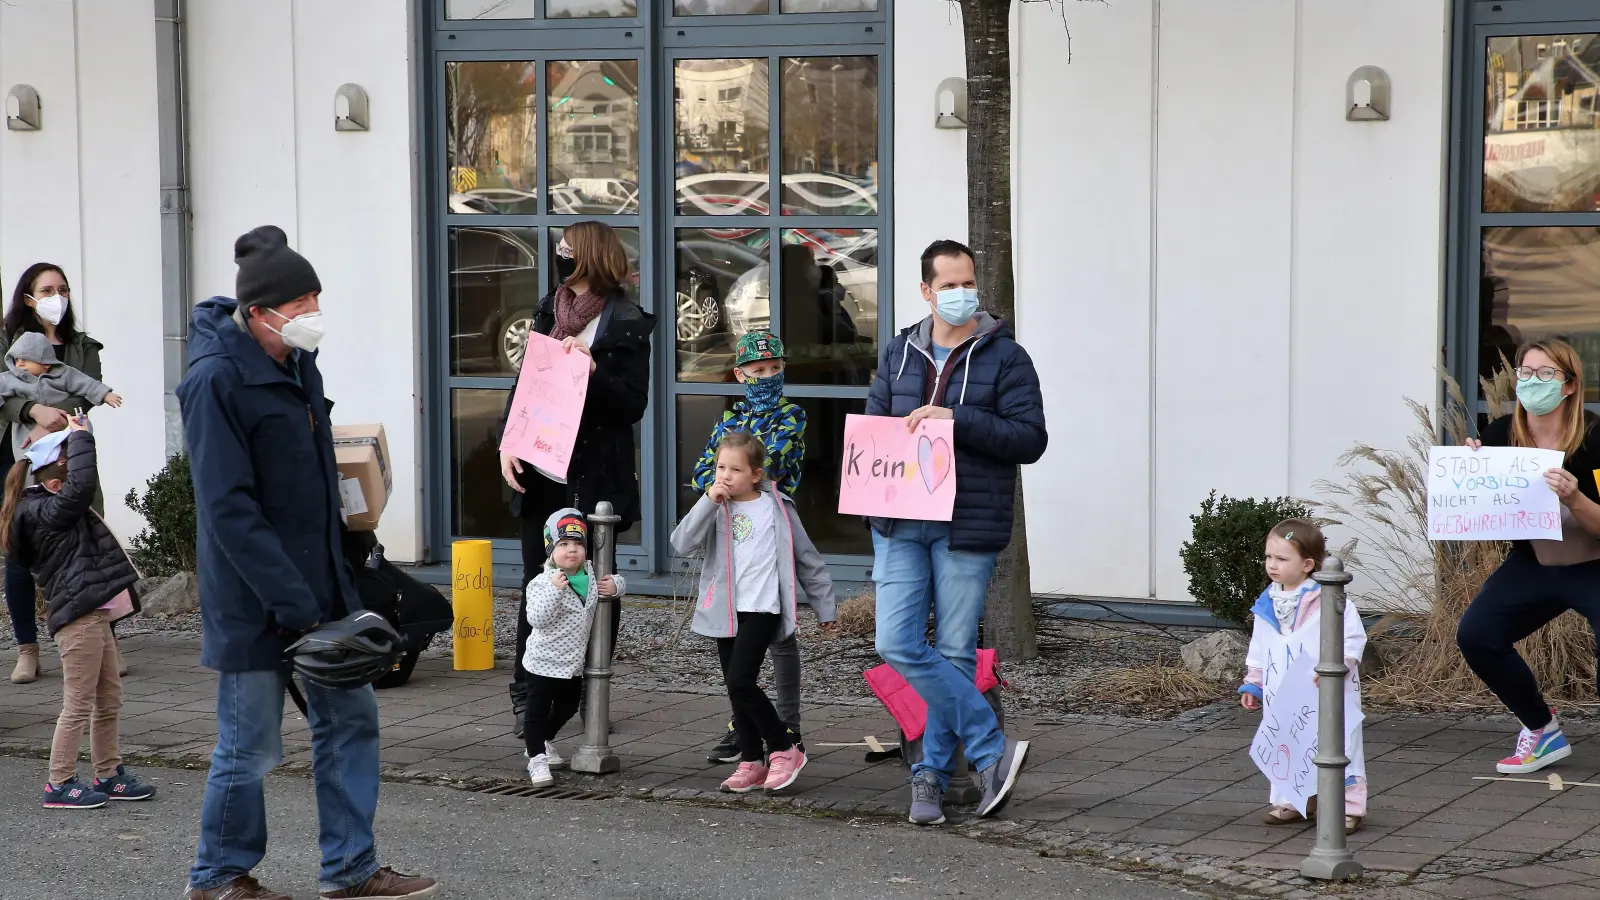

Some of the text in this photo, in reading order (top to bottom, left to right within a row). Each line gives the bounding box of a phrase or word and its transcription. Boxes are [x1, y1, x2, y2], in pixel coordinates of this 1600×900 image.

[1435, 457, 1541, 477] STADT ALS
[1452, 474, 1530, 490] VORBILD
[1432, 494, 1521, 508] NICHT ALS
[1289, 704, 1316, 744] FÜR
[1257, 713, 1281, 766] EIN
[1292, 731, 1319, 797] KINDE
